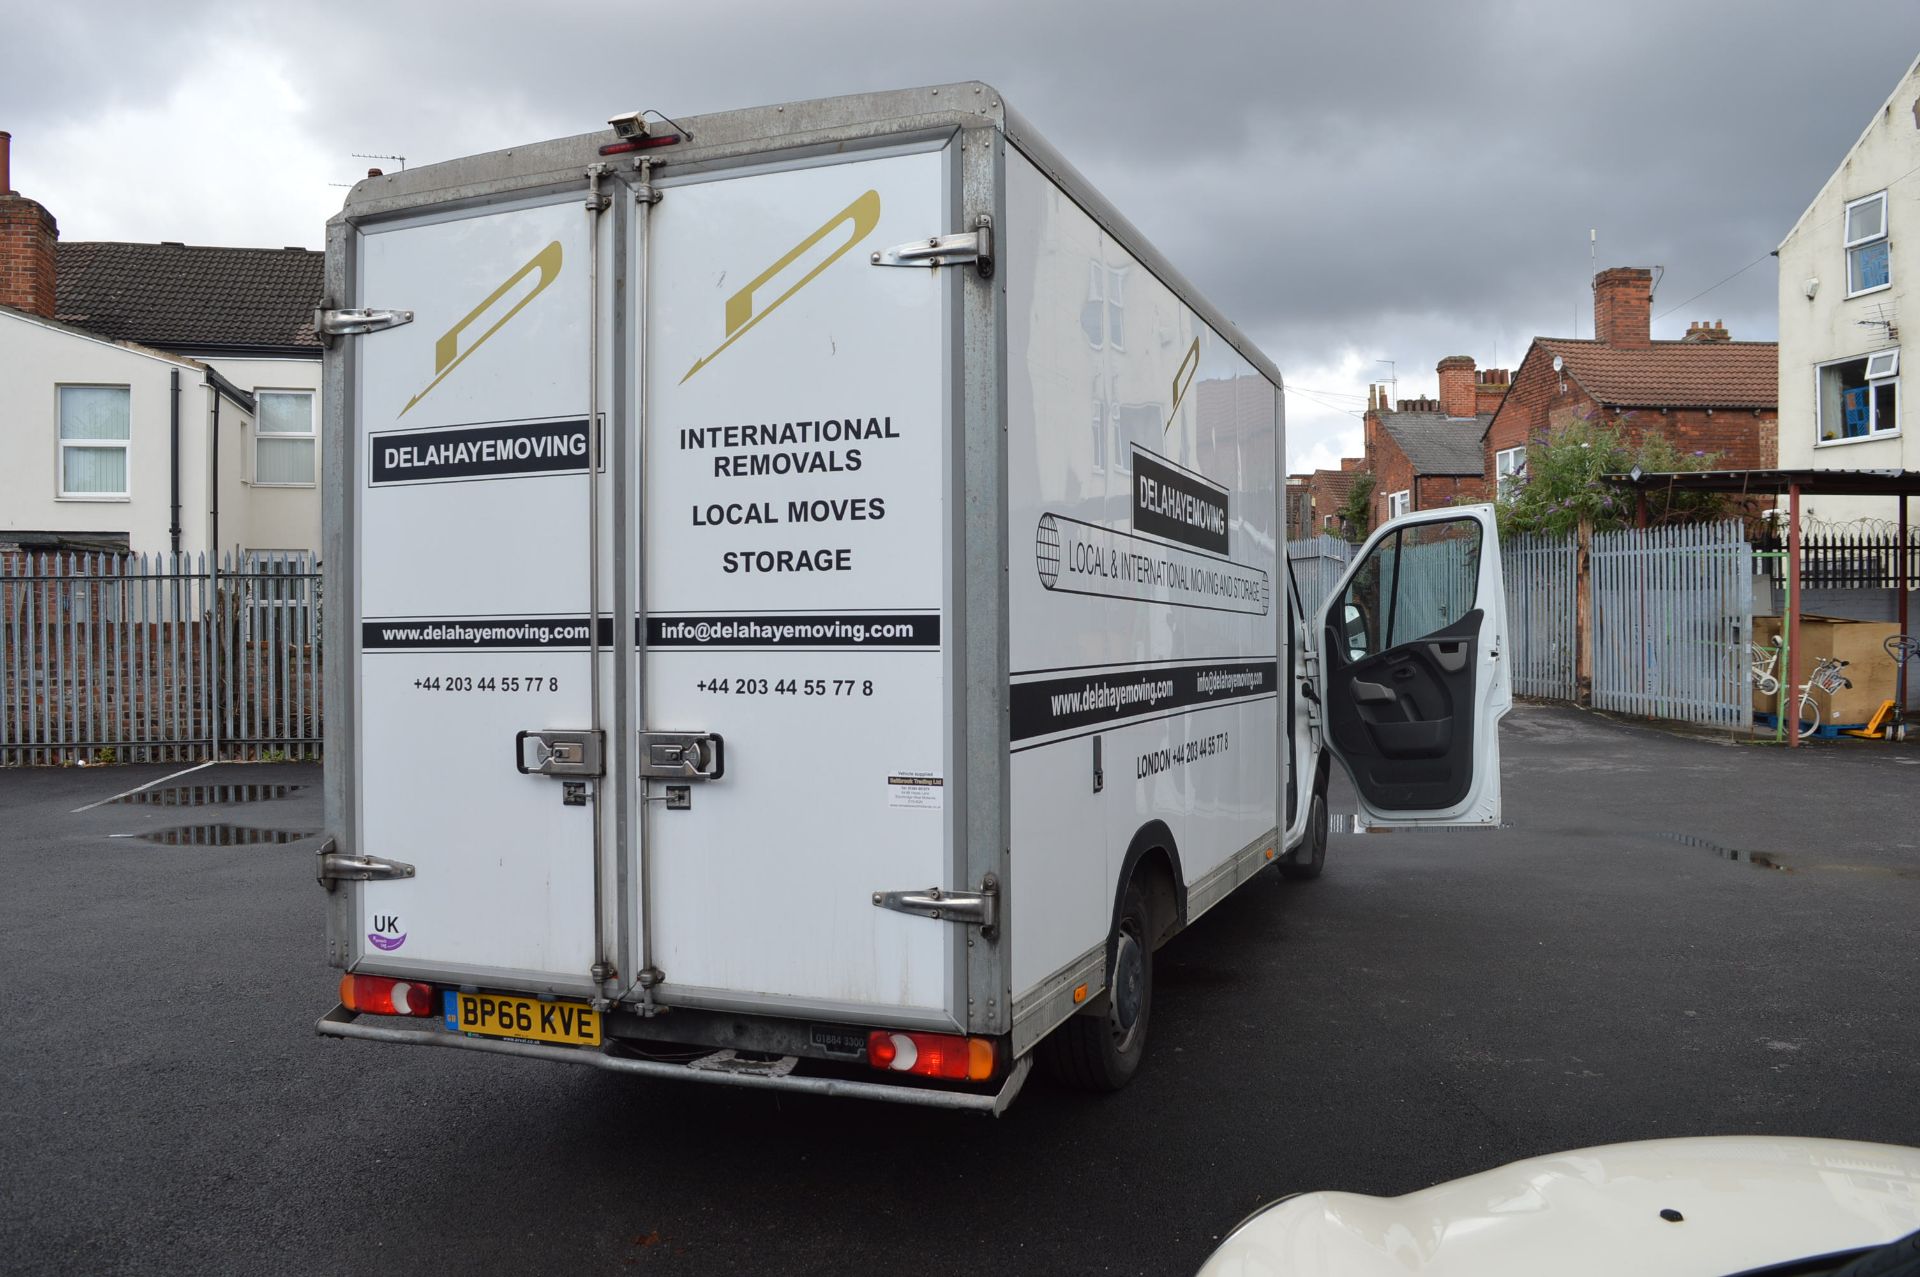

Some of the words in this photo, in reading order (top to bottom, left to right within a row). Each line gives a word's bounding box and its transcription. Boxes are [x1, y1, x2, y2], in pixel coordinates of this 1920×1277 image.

[680, 416, 900, 450] INTERNATIONAL
[384, 433, 587, 469] DELAHAYEMOVING
[714, 448, 862, 478] REMOVALS
[692, 503, 779, 526] LOCAL
[788, 498, 886, 523] MOVES
[1140, 475, 1225, 536] DELAHAYEMOVING
[722, 549, 852, 573] STORAGE
[1069, 540, 1108, 578] LOCAL
[1110, 549, 1118, 579] &
[1121, 551, 1189, 591] INTERNATIONAL
[1191, 567, 1219, 595] MOVING
[1220, 573, 1232, 598] AND
[1234, 577, 1260, 602] STORAGE
[382, 623, 590, 644] www.delahayemoving.com
[661, 621, 914, 642] info@delahayemoving.com
[414, 677, 441, 692] +44
[445, 677, 472, 692] 203
[477, 677, 496, 692] 44
[501, 677, 520, 692] 55
[525, 677, 543, 692] 77
[549, 677, 558, 692] 8
[696, 678, 729, 694] +44
[736, 679, 768, 694] 203
[775, 679, 797, 695] 44
[804, 679, 826, 696] 55
[833, 680, 855, 696] 77
[862, 680, 874, 697] 8
[1051, 677, 1174, 716] www.delahayemoving.com
[1197, 668, 1263, 696] info@delahayemoving.com
[1137, 748, 1171, 779] LONDON
[1172, 744, 1185, 766] +44
[1186, 741, 1198, 763] 203
[1199, 738, 1207, 758] 44
[1208, 735, 1215, 756] 55
[1216, 733, 1223, 753] 77
[1224, 731, 1229, 751] 8
[374, 915, 399, 933] UK
[462, 997, 532, 1032] BP66
[540, 1004, 594, 1039] KVE
